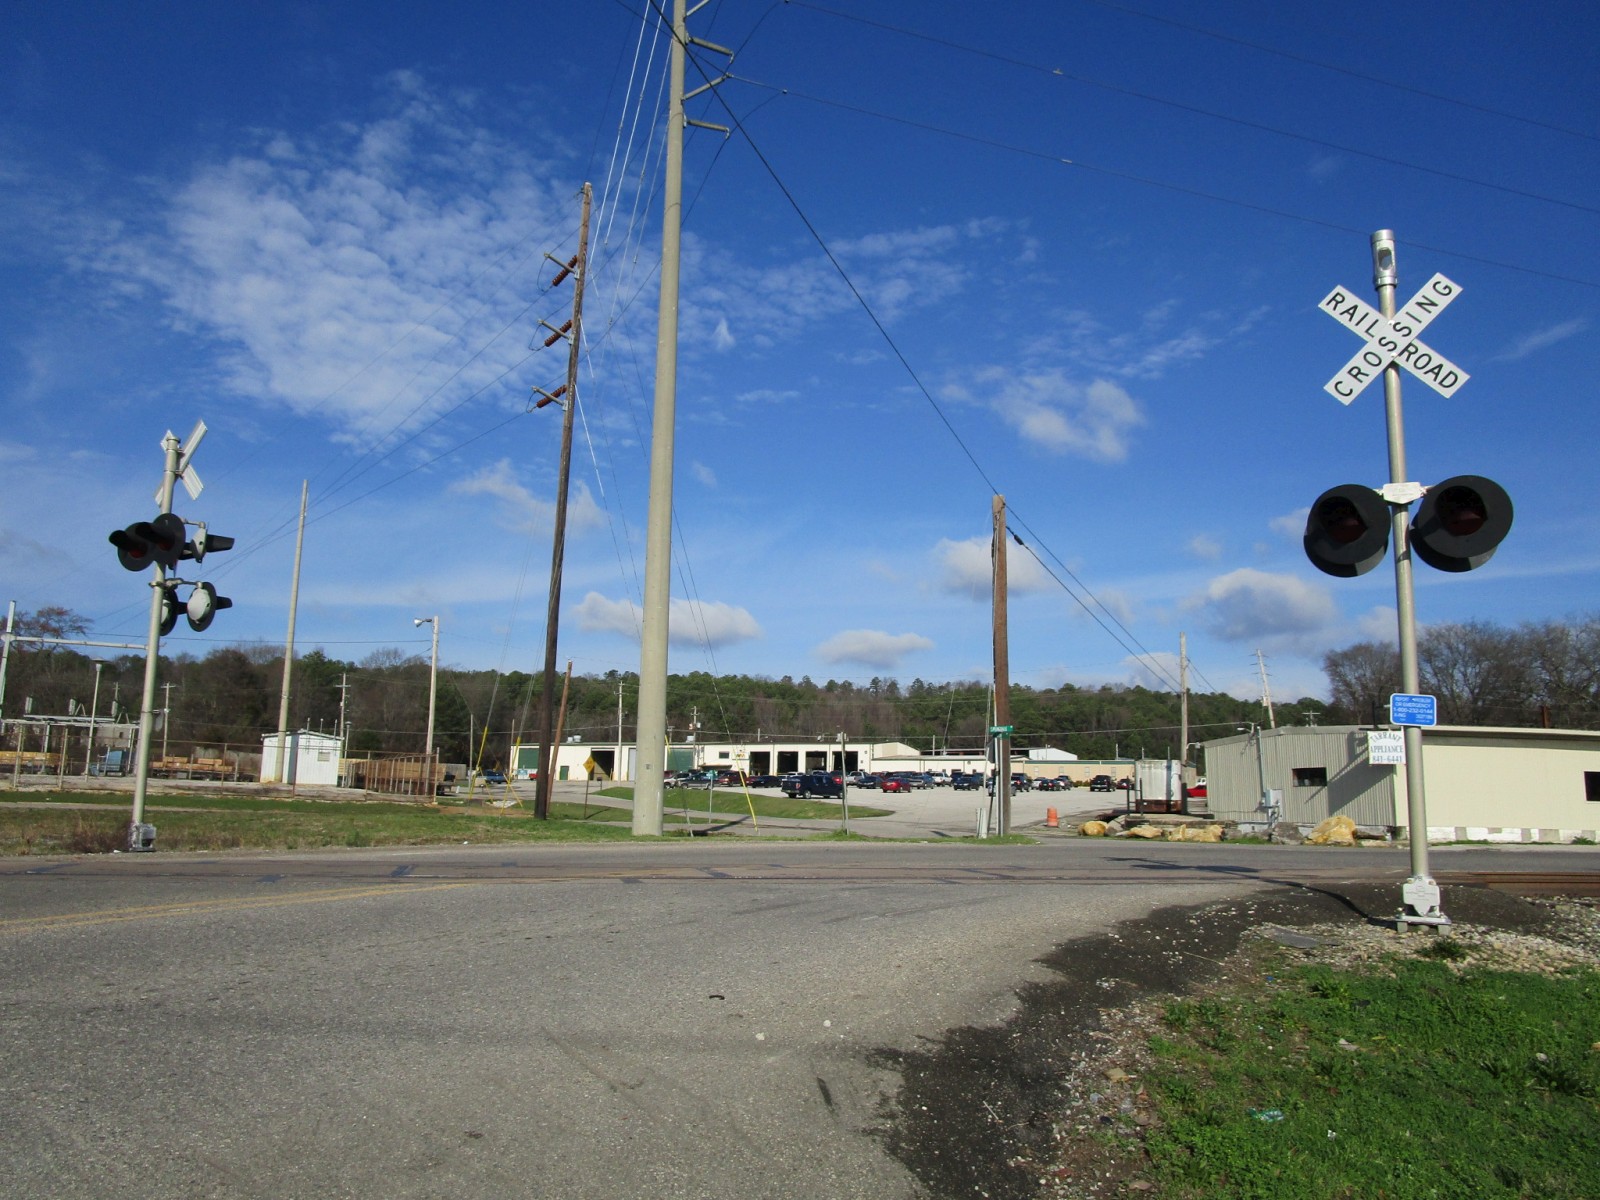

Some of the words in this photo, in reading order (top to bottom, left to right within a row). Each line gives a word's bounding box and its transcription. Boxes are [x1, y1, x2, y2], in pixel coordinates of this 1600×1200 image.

[1334, 280, 1453, 397] CROSSING
[1370, 731, 1402, 743] TARRANT
[1370, 745, 1403, 753] APPLIANCE
